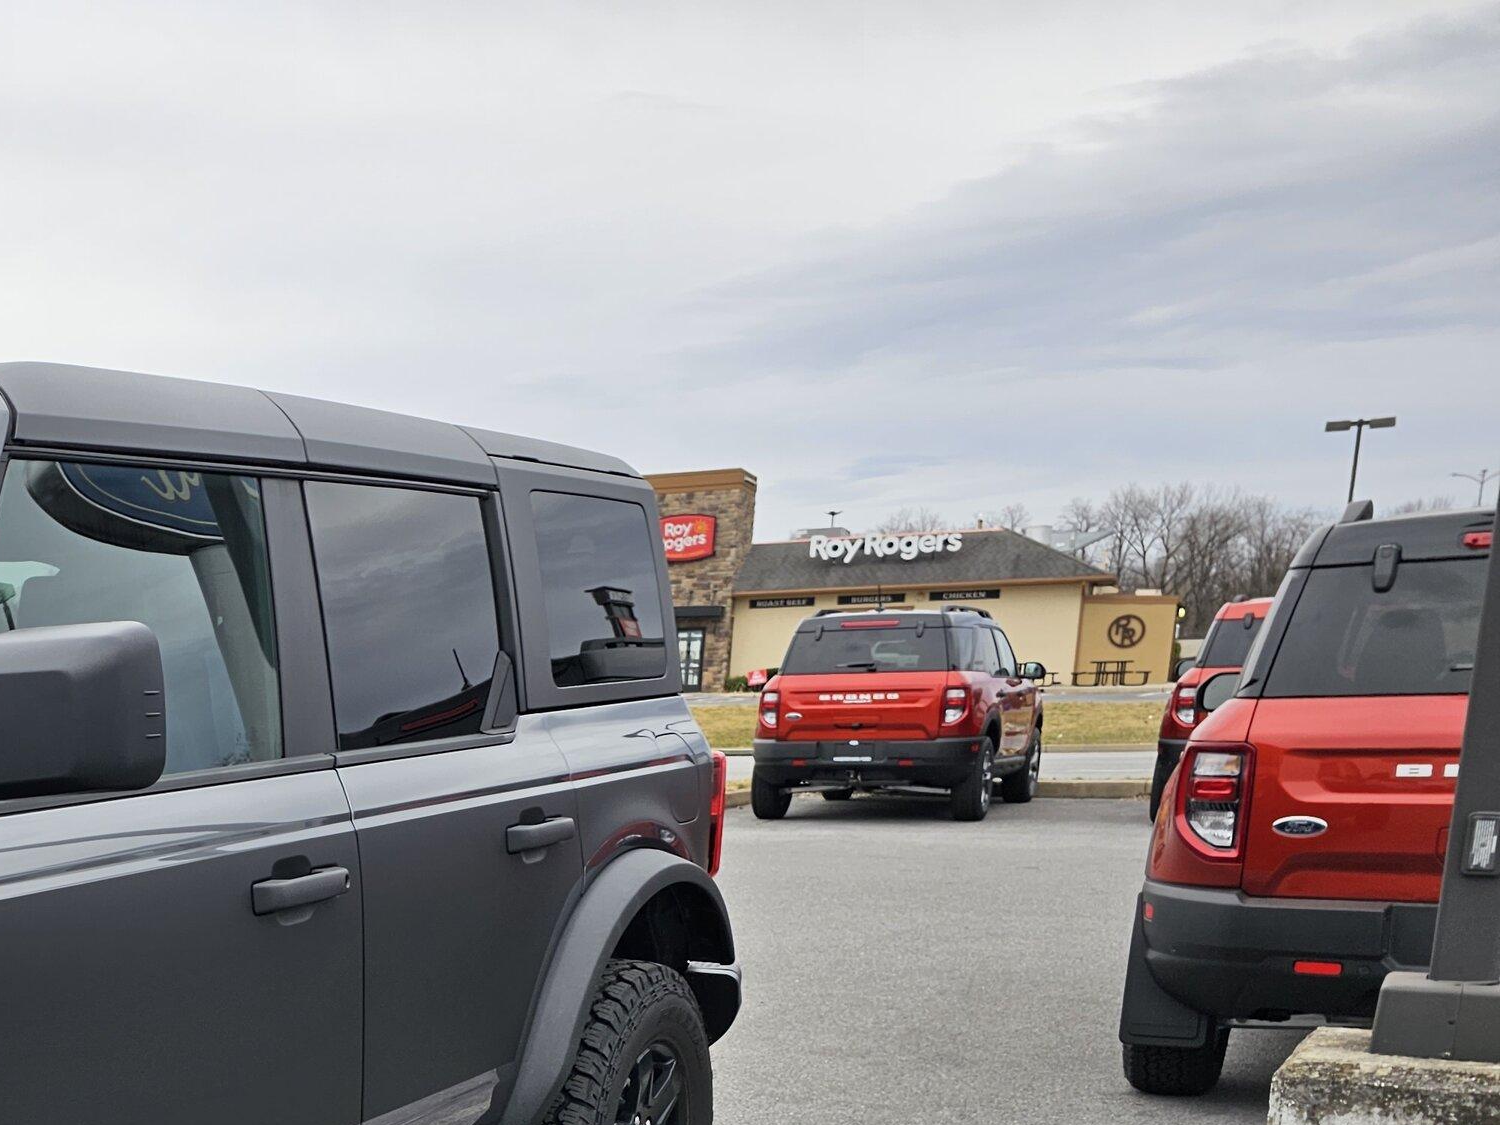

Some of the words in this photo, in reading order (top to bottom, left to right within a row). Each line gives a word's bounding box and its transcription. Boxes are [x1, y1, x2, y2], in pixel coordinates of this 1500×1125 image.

[664, 522, 693, 538] Roy
[809, 534, 863, 564] Roy
[863, 533, 963, 561] Rogers
[942, 591, 987, 600] CHICKEN
